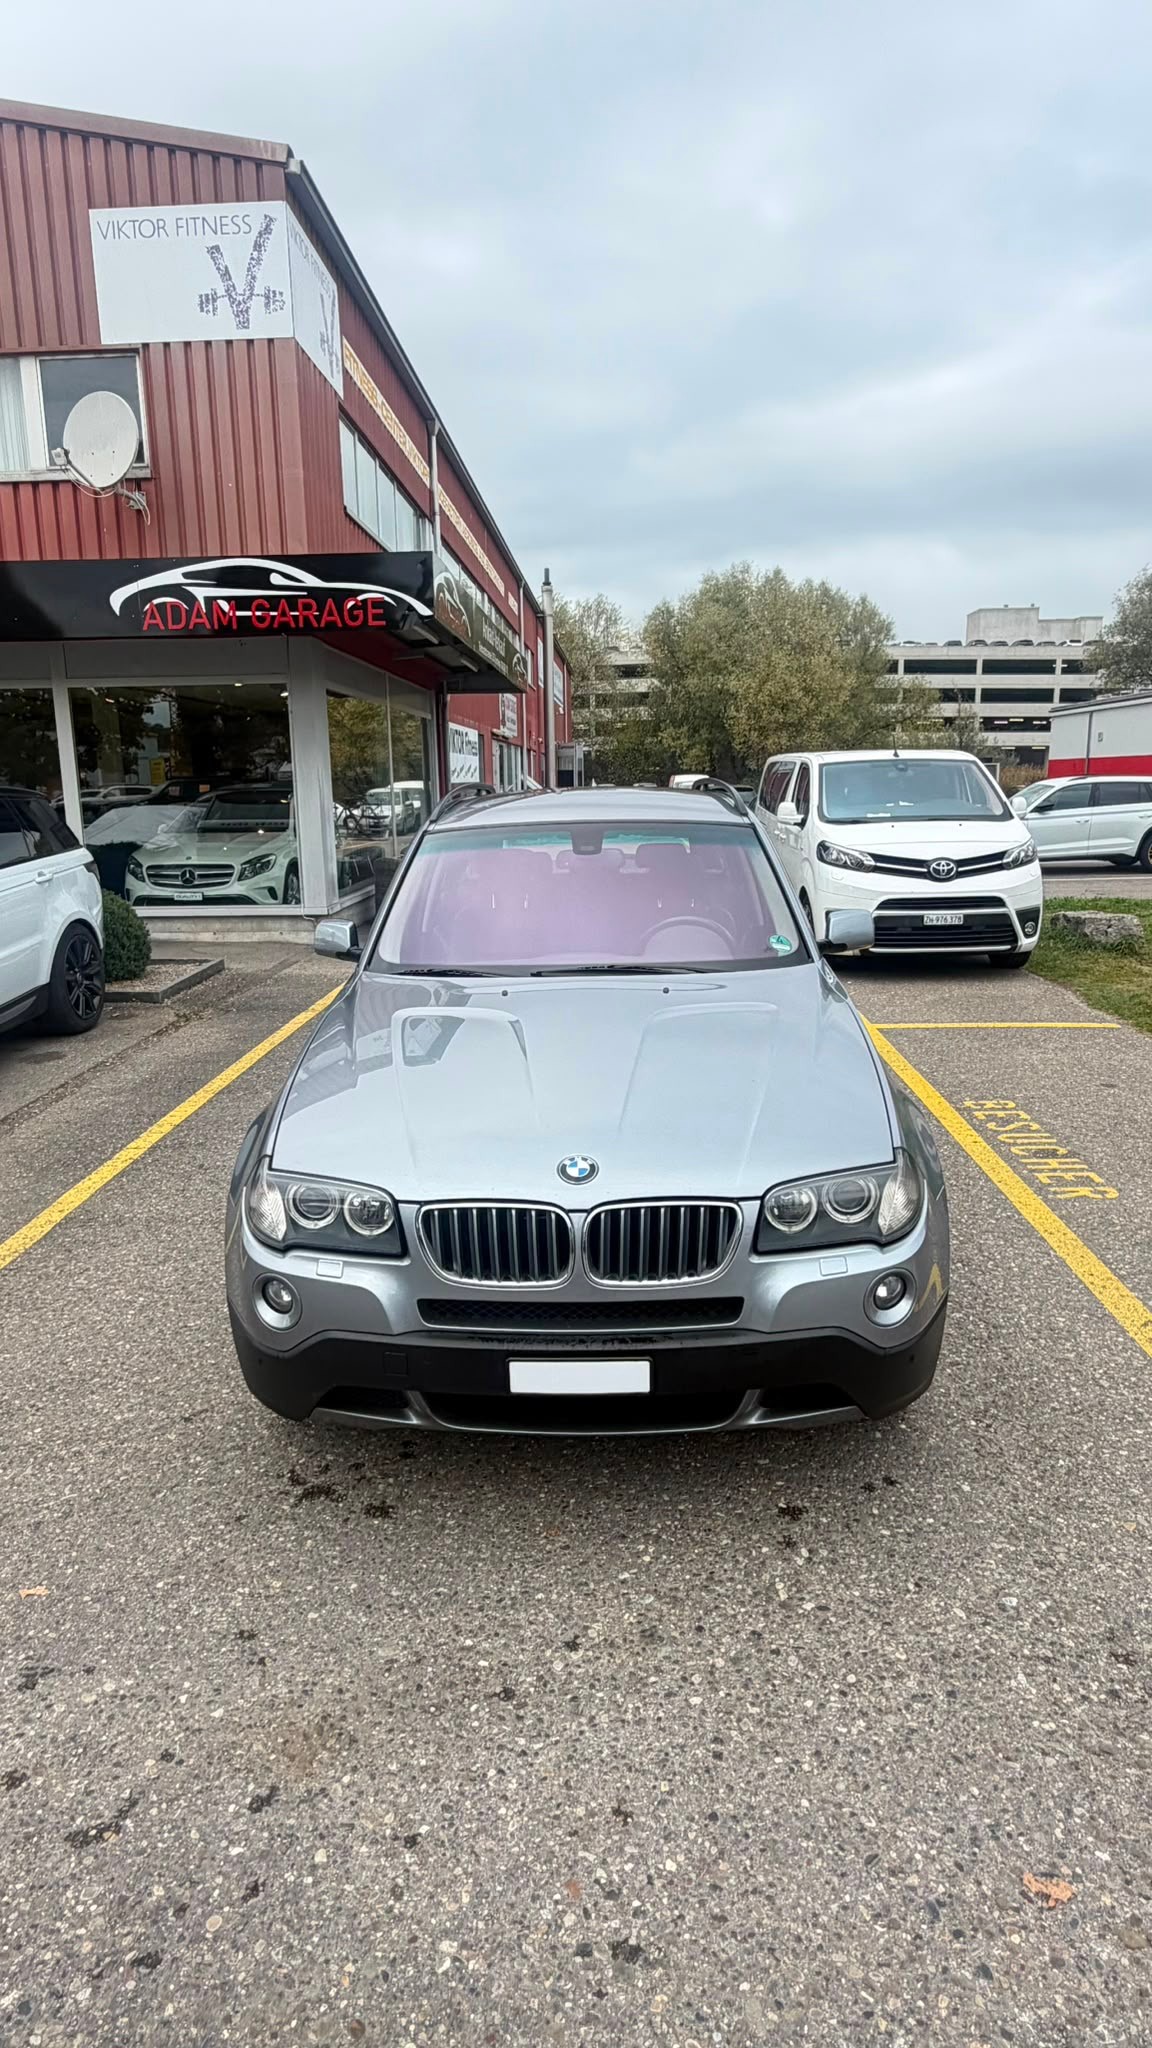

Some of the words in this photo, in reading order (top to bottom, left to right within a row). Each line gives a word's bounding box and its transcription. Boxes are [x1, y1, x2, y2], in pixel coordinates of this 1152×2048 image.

[97, 218, 169, 241] VIKTOR
[175, 214, 252, 237] FITNESS
[143, 600, 238, 631] ADAM
[251, 597, 386, 629] GARAGE
[963, 1100, 1119, 1200] BESUCHER
